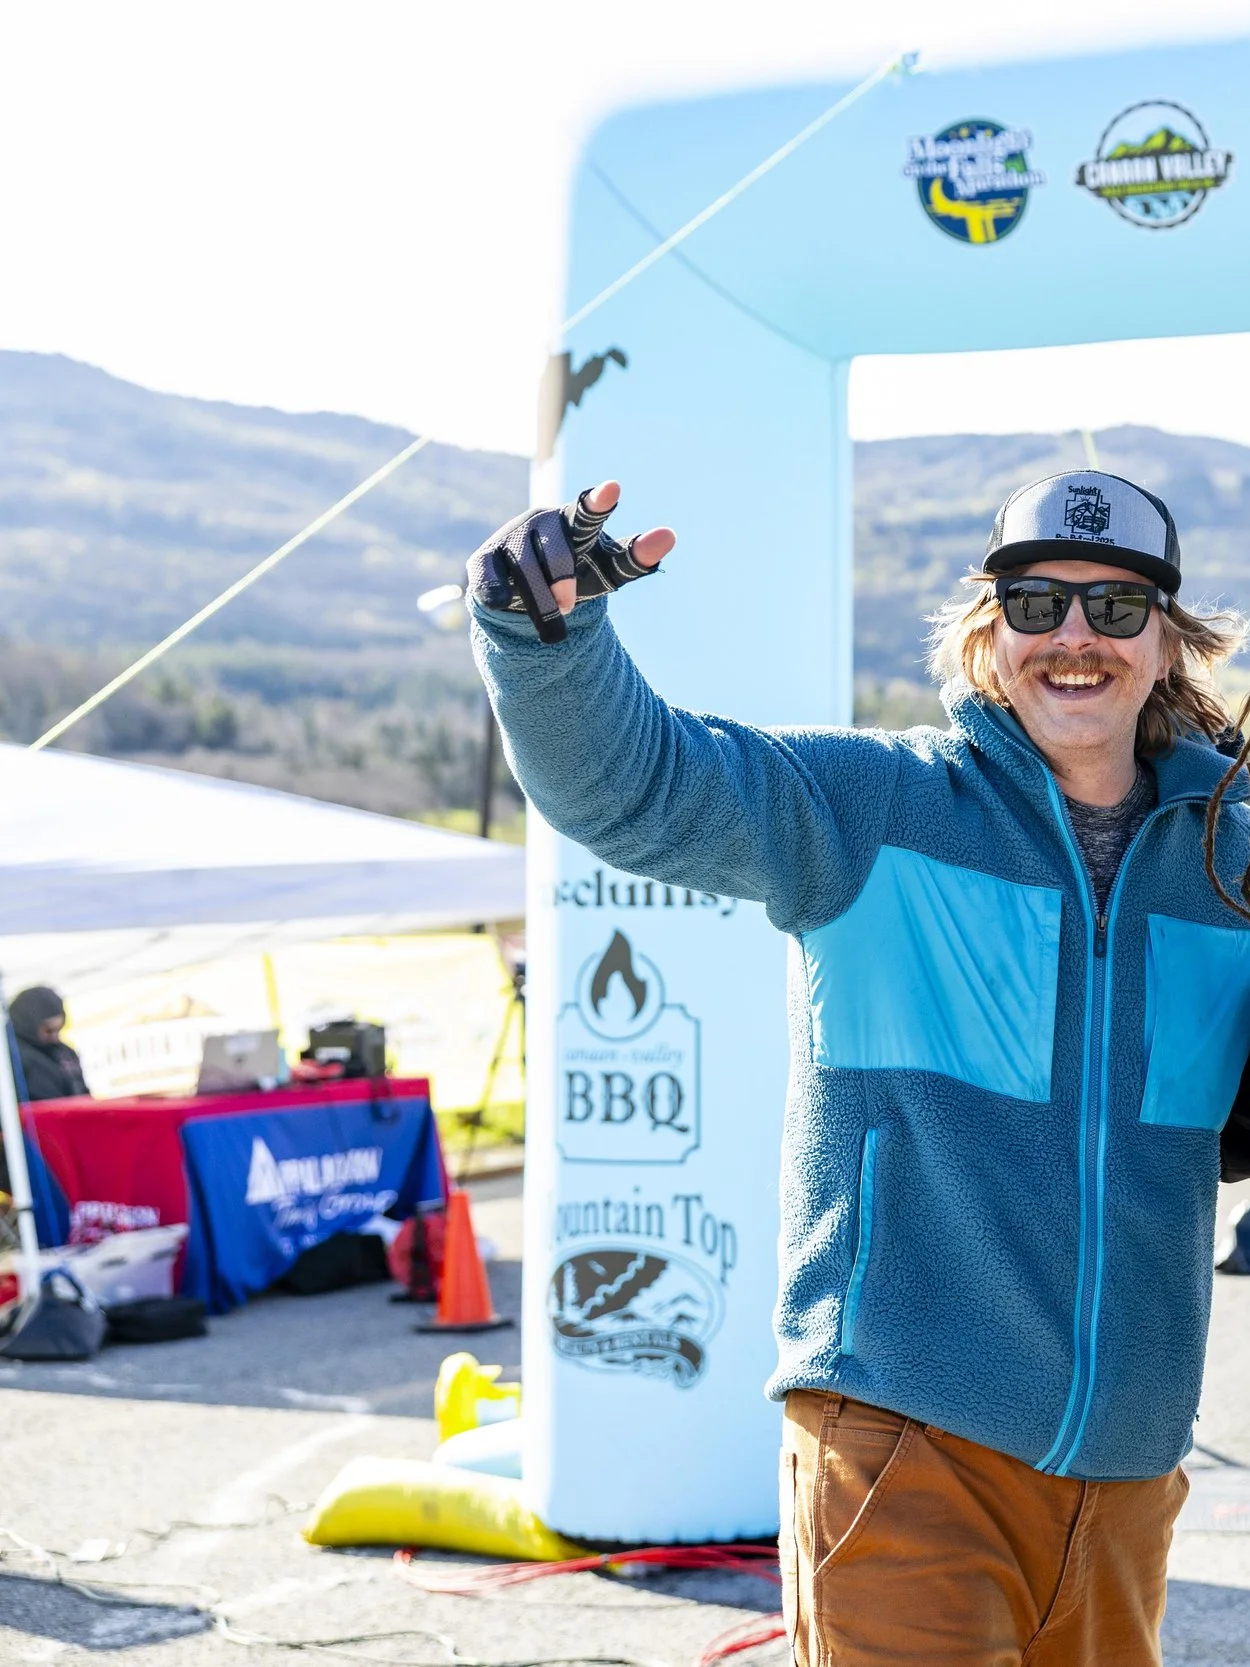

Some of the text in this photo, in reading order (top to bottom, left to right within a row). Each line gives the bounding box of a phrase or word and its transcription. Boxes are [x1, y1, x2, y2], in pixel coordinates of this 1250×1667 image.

[1158, 150, 1228, 181] VALLEY
[1068, 485, 1097, 496] Sunlight
[564, 1069, 690, 1134] BBQ
[557, 1185, 738, 1287] untain Top
